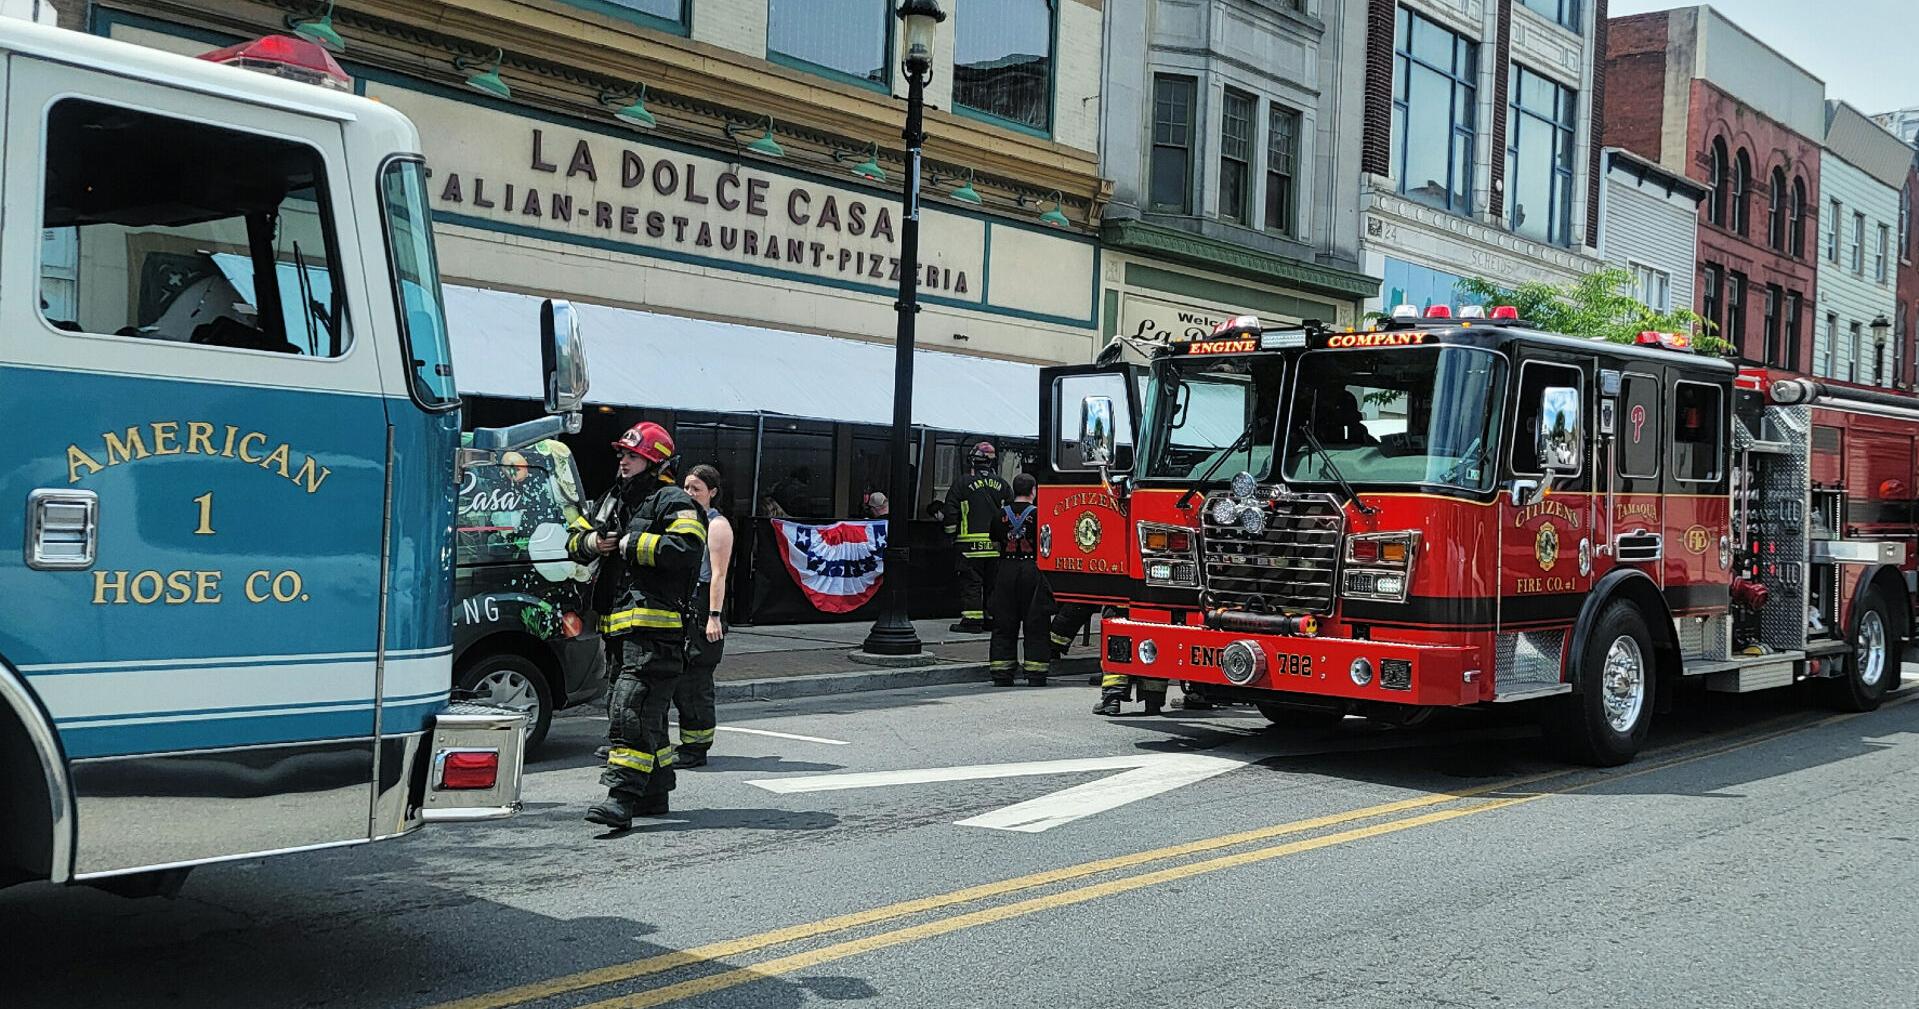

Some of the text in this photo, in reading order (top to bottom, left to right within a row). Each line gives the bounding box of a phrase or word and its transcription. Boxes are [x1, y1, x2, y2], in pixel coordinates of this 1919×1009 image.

[532, 129, 895, 244] LA DOLCE CASA
[1188, 332, 1427, 354] ENGINE COMPANY
[66, 421, 331, 494] AMERICAN
[193, 491, 216, 534] 1
[1053, 492, 1128, 517] CITIZENS
[1515, 500, 1579, 528] CITIZENS
[1617, 503, 1657, 522] TAMAQUA
[1056, 557, 1083, 571] FIRE
[91, 570, 311, 605] HOSE CO.
[1517, 578, 1542, 593] FIRE
[1277, 652, 1313, 678] 782
